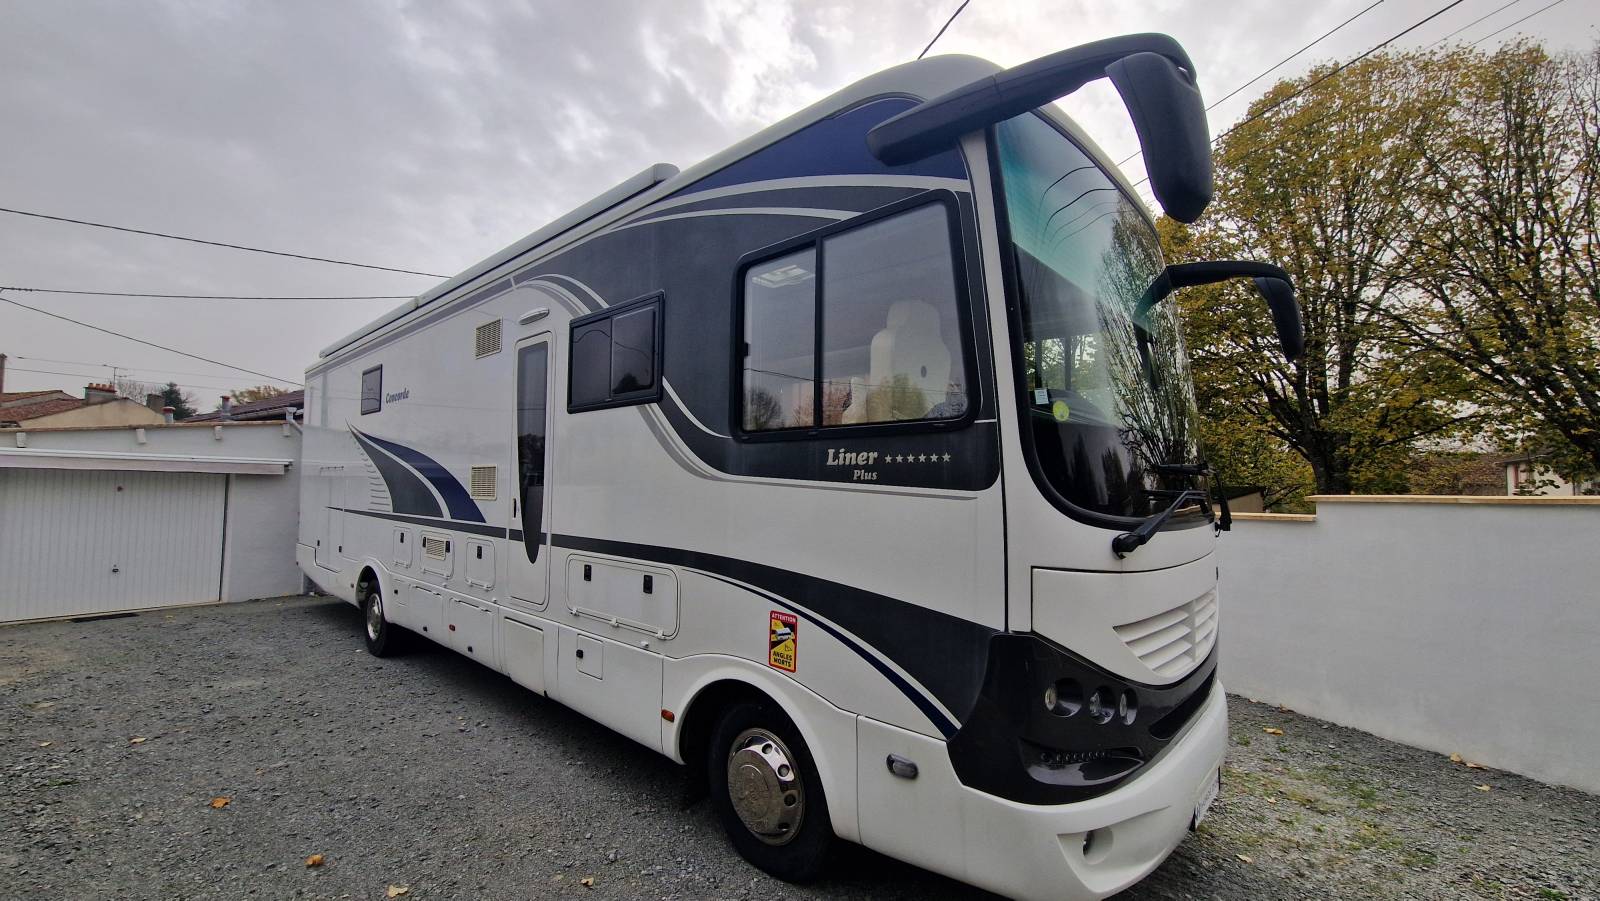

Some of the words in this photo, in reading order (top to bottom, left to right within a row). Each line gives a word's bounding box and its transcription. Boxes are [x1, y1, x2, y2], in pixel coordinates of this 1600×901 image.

[826, 448, 878, 466] Liner
[853, 469, 878, 481] Plus
[771, 612, 796, 624] ATTENTION
[772, 650, 792, 661] ANGLES
[773, 657, 792, 667] MORTS
